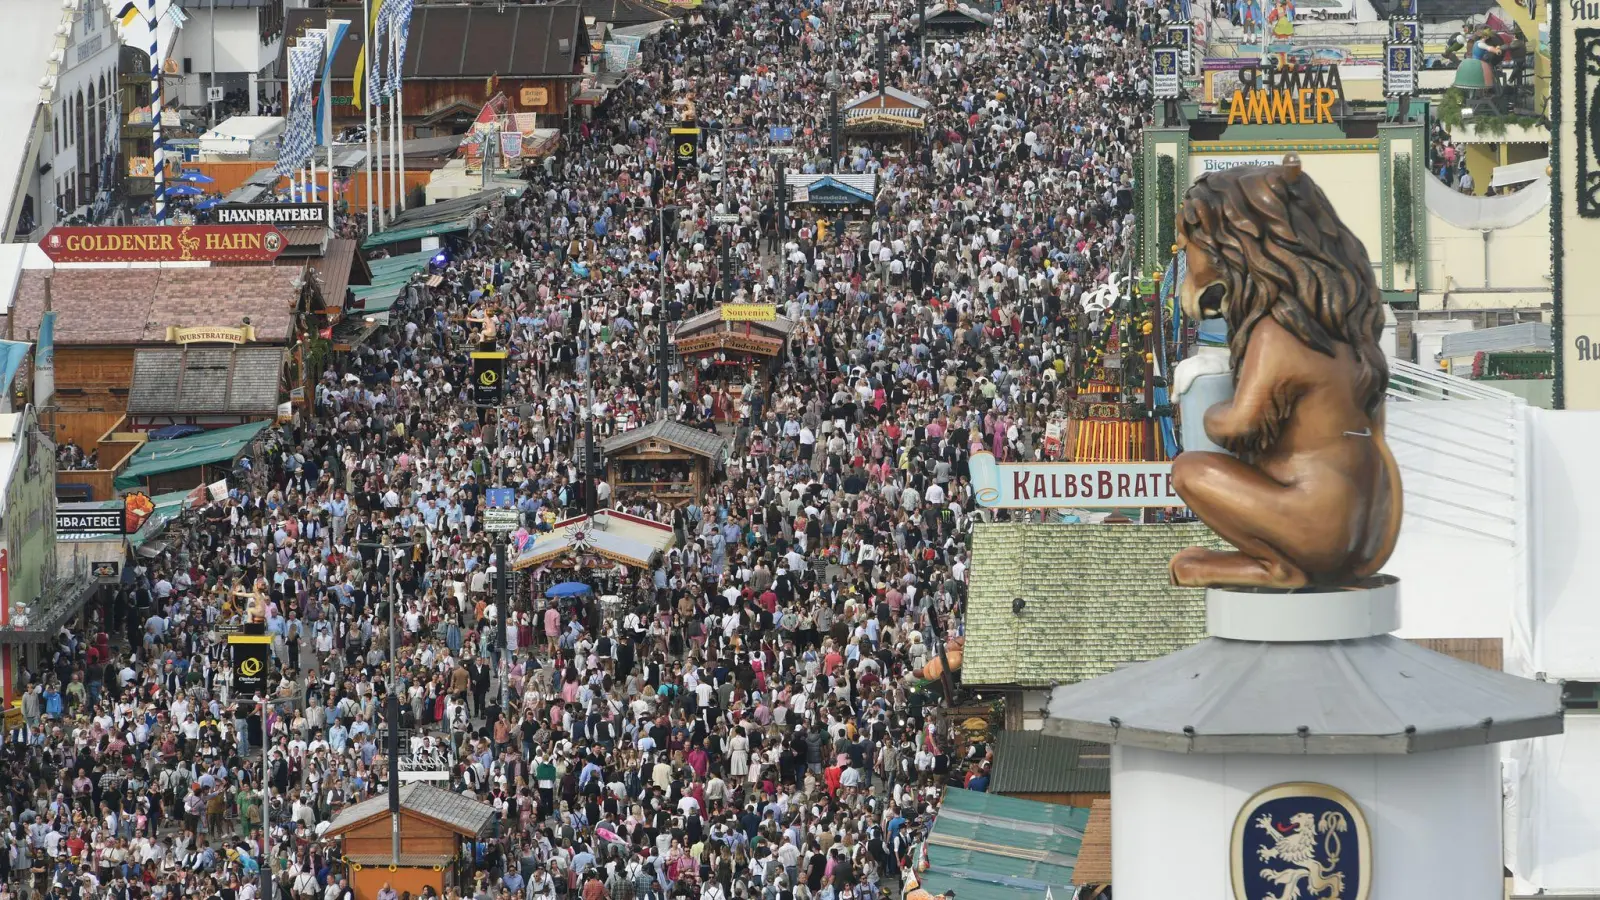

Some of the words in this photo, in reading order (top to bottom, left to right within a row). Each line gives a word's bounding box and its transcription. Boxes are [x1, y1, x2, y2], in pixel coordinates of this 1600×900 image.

[1227, 88, 1335, 125] AMMER
[218, 208, 323, 222] HAXNBRATEREI
[66, 234, 174, 251] GOLDENER
[205, 233, 261, 250] HAHN
[726, 309, 770, 317] Souvenirs
[179, 332, 242, 342] WURSTBRATEREI
